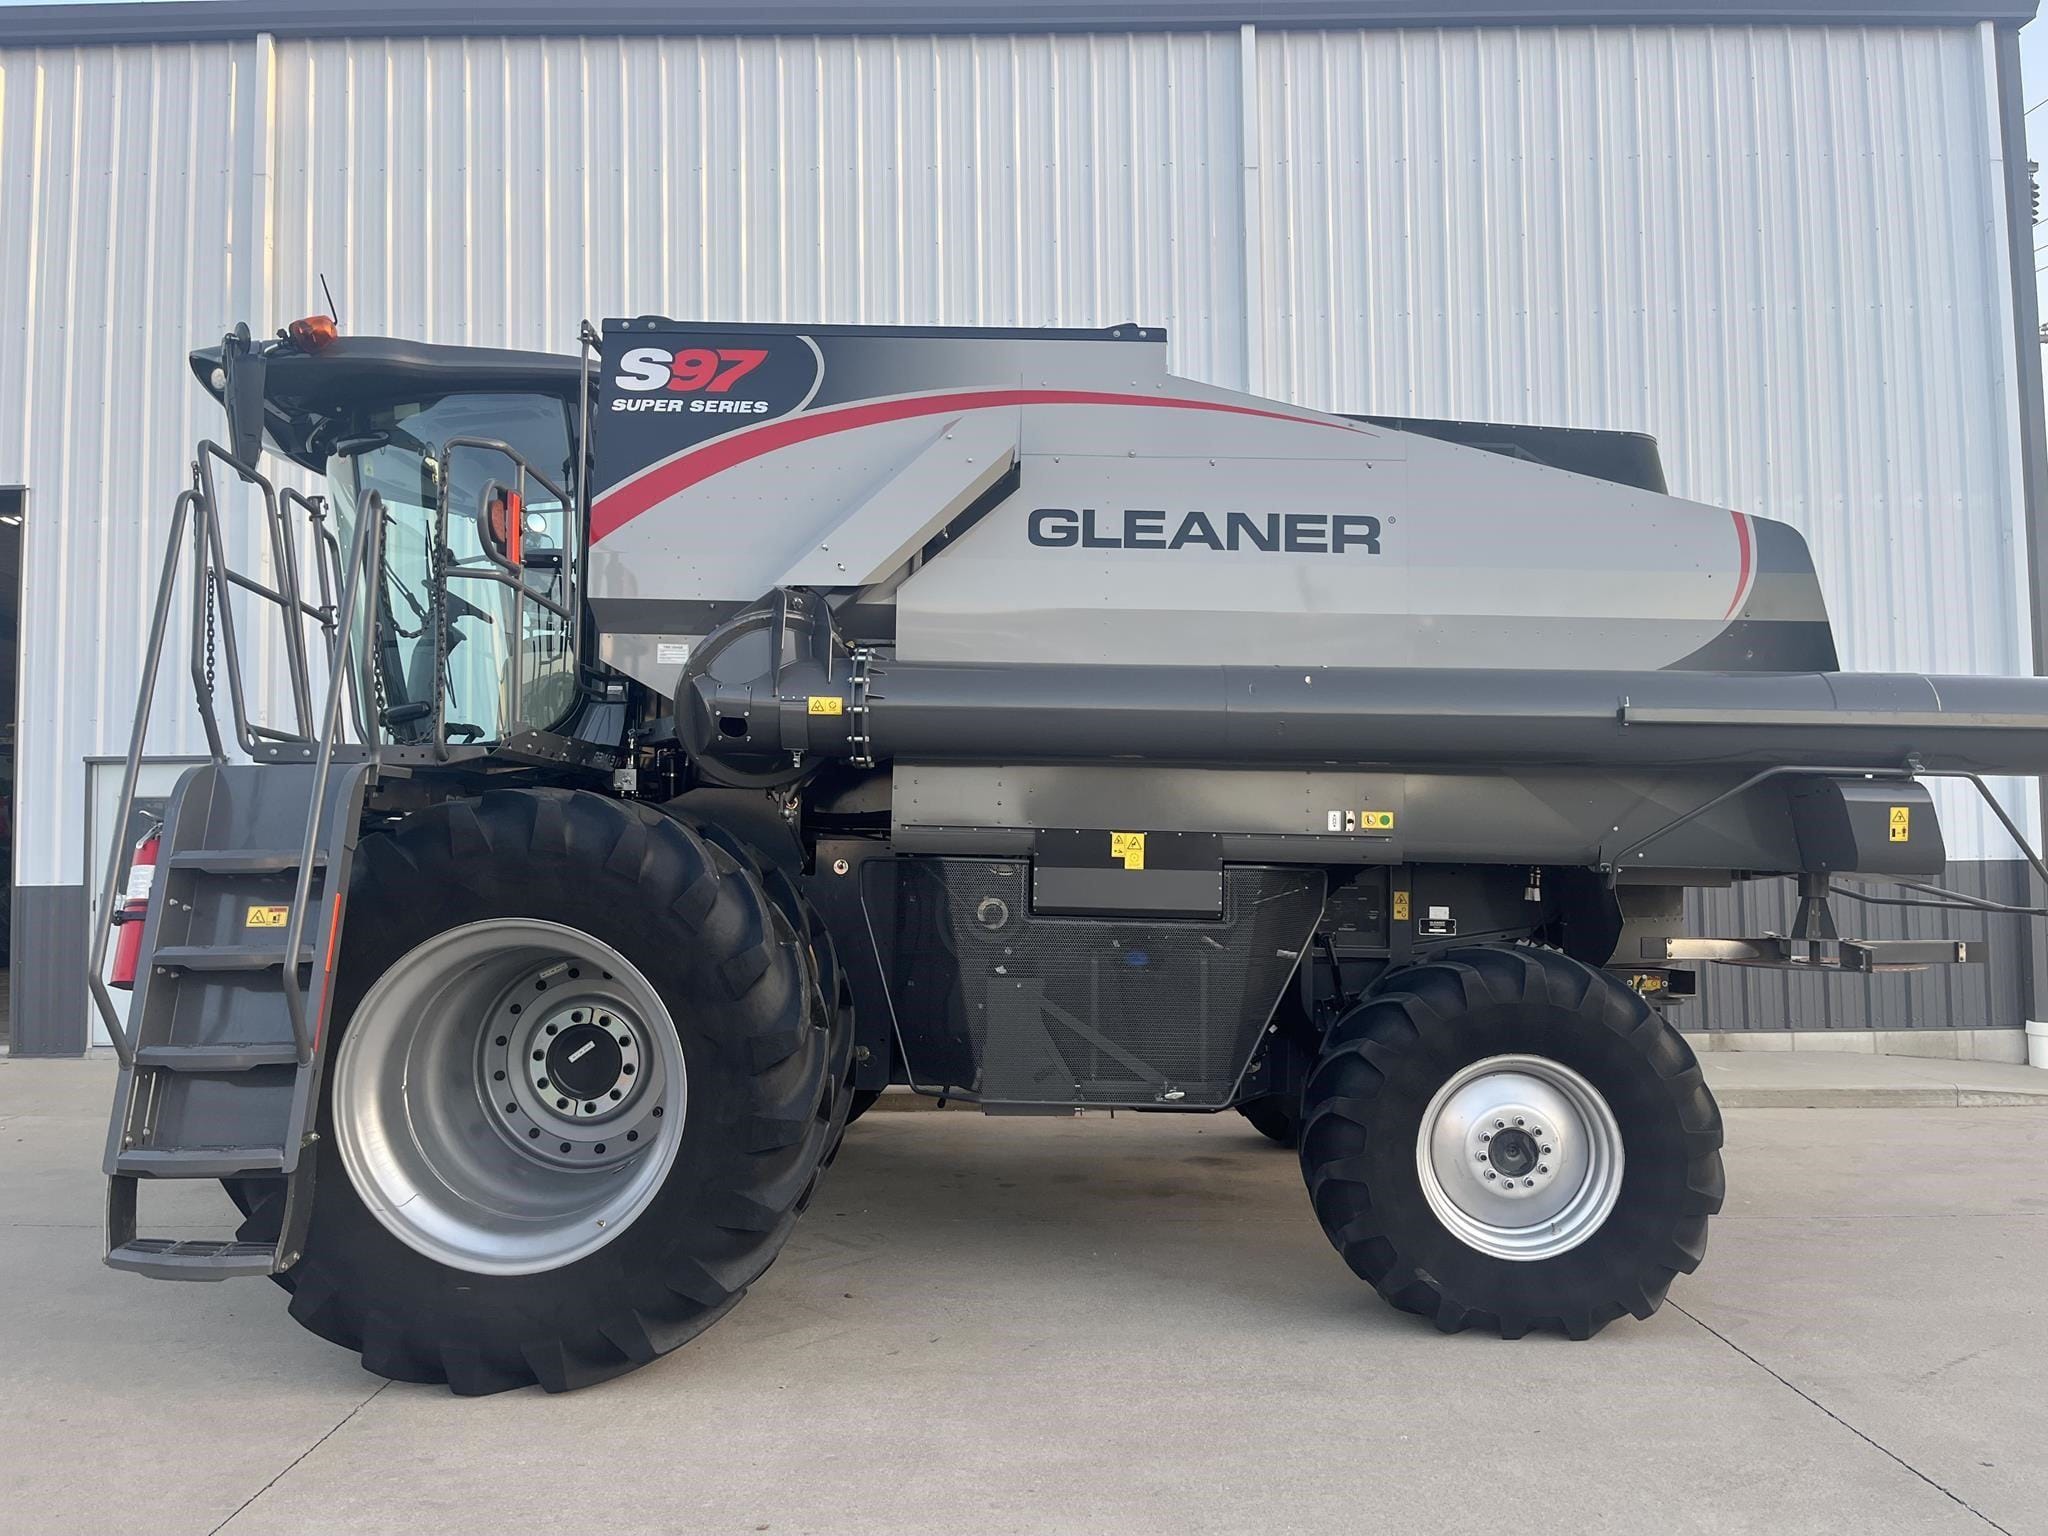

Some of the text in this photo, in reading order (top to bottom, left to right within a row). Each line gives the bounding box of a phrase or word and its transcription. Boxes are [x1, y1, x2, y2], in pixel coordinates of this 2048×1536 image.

[615, 348, 769, 392] S97
[611, 399, 769, 414] SUPER SERIES
[1027, 508, 1381, 555] GLEANER
